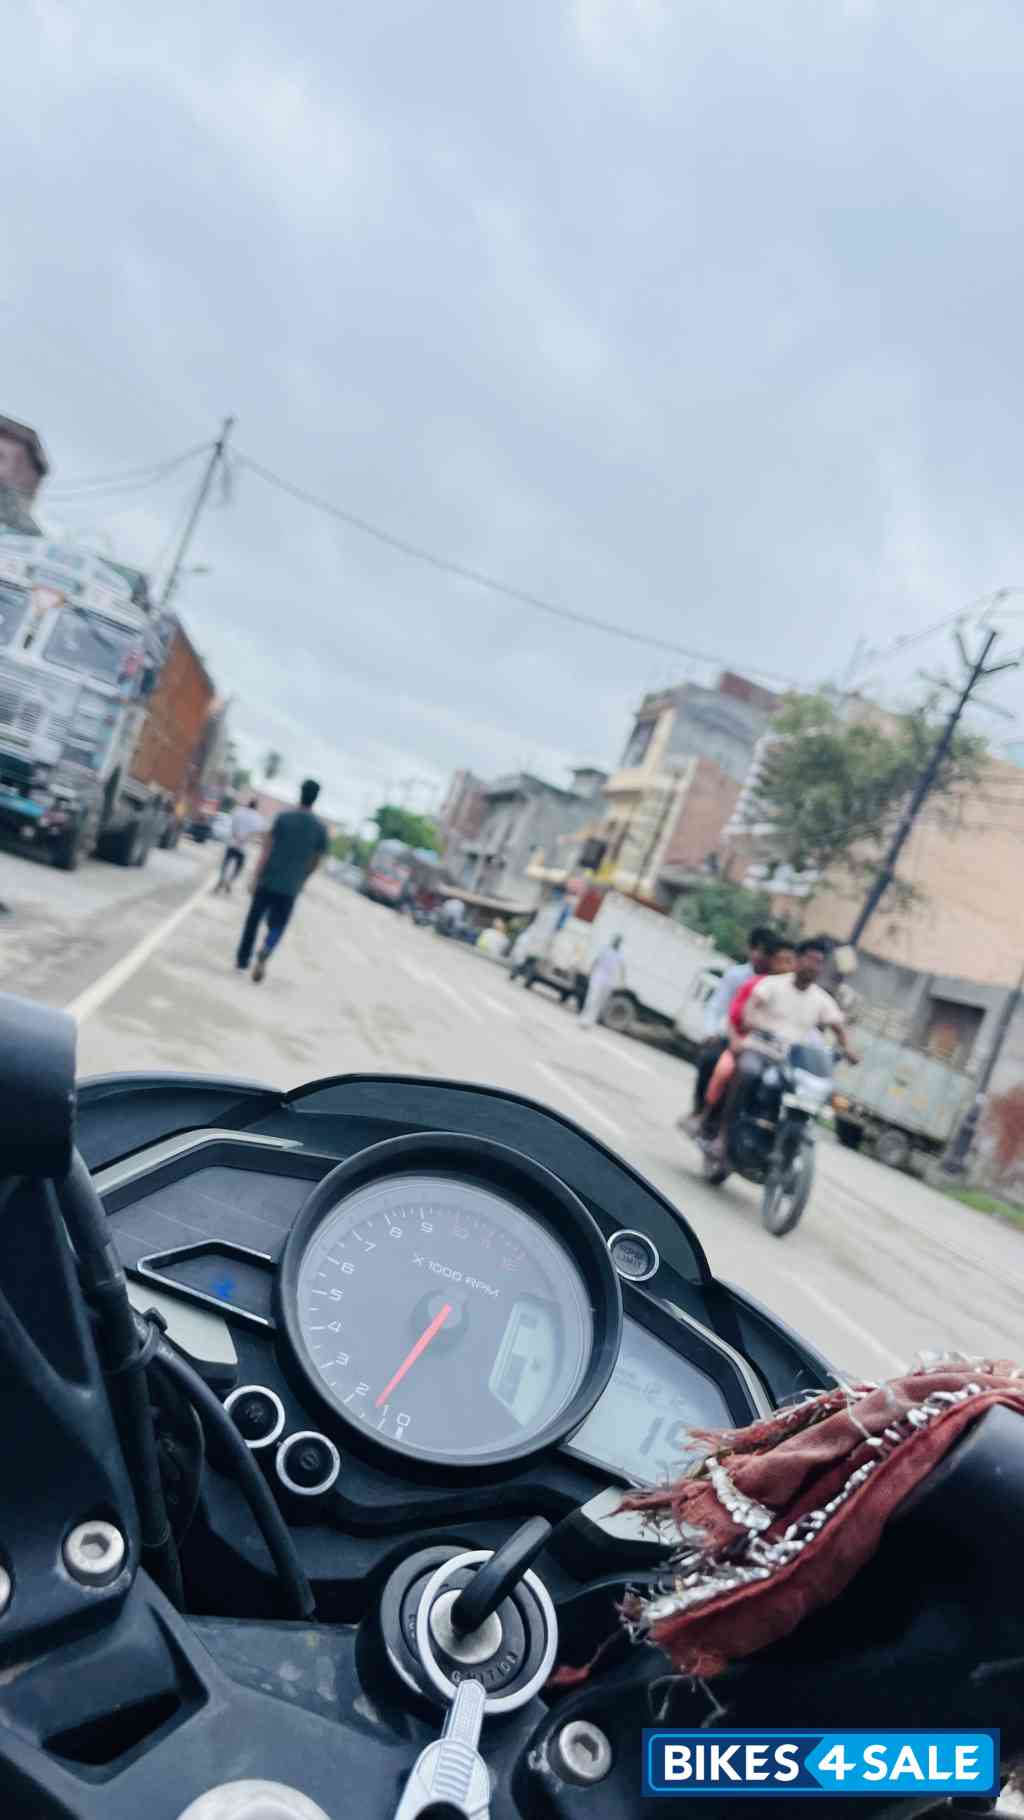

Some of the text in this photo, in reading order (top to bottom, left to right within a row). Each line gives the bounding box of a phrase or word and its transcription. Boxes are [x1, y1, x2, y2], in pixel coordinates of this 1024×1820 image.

[390, 1226, 402, 1239] 8
[421, 1222, 433, 1233] 9
[363, 1240, 377, 1252] 7
[341, 1262, 355, 1274] 6
[428, 1260, 463, 1282] 1000
[464, 1276, 500, 1297] RPM
[330, 1287, 344, 1302] 5
[327, 1320, 342, 1333] 4
[336, 1352, 350, 1367] 3
[355, 1381, 370, 1397] 2
[396, 1412, 411, 1427] 0
